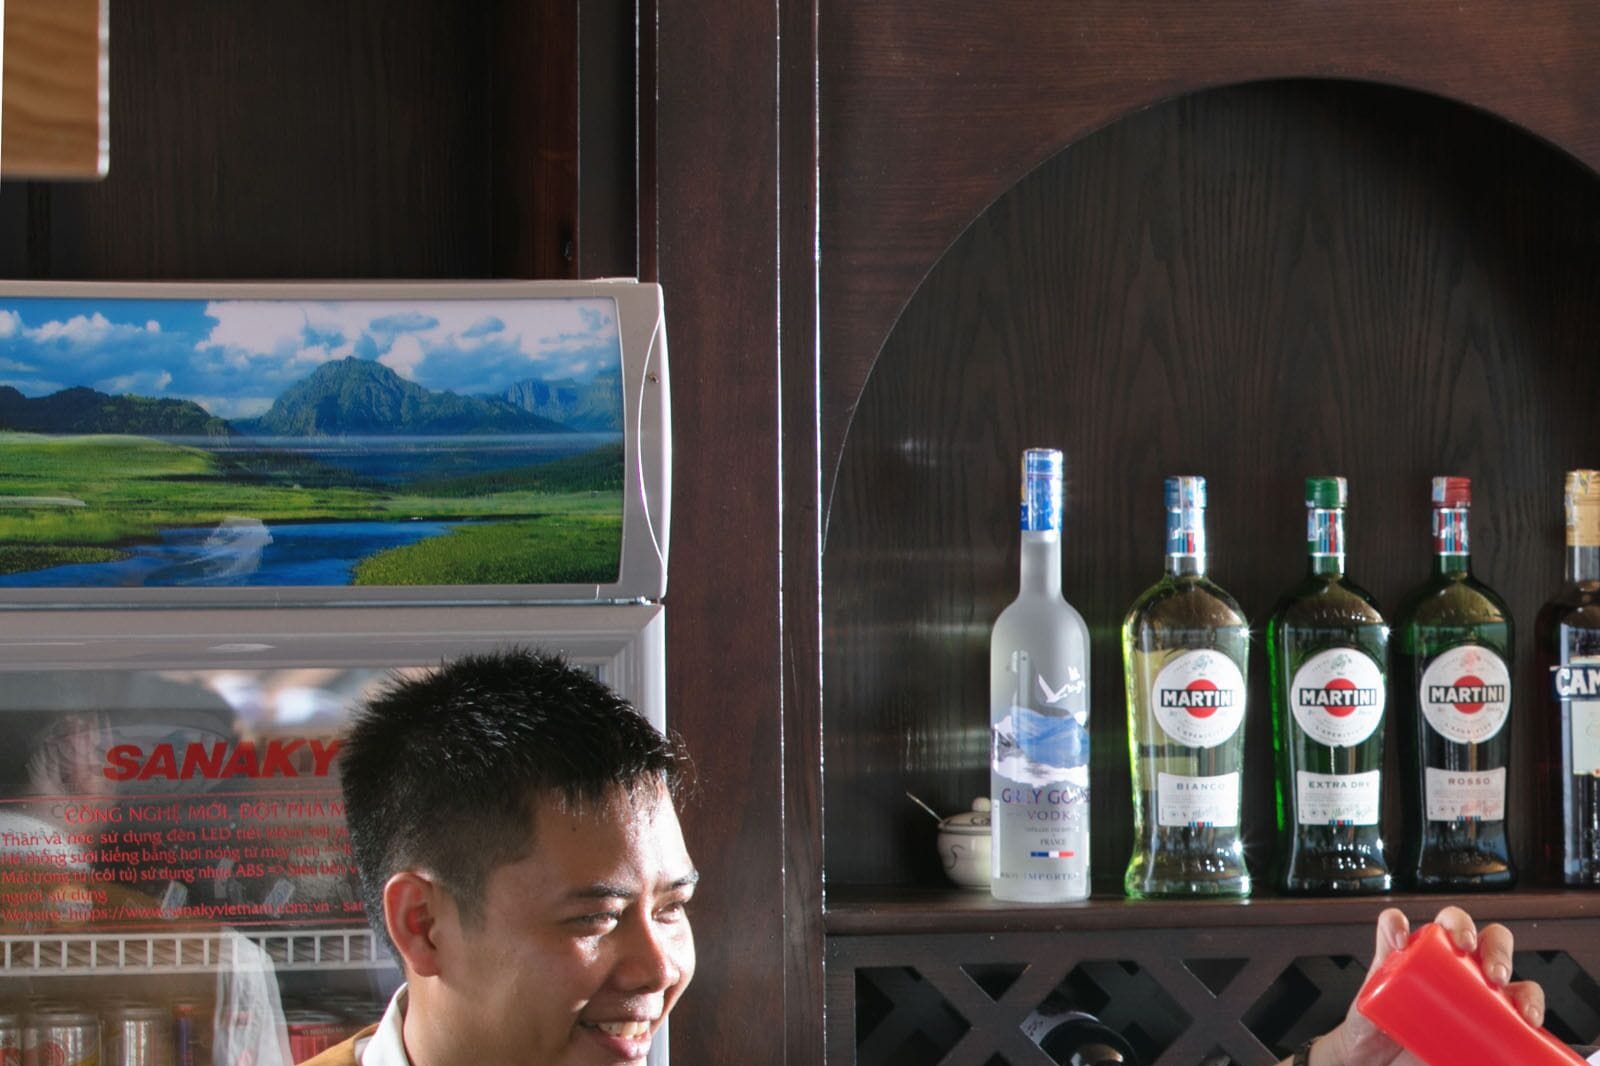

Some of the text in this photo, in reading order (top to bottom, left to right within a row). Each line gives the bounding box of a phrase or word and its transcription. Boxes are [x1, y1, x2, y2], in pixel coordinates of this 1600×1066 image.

[1302, 688, 1377, 706] MARTINI
[1431, 685, 1504, 704] MARTINI
[103, 738, 342, 782] SANAKY
[1176, 782, 1226, 792] BIANCO
[1308, 780, 1347, 790] EXTRA
[1448, 777, 1491, 786] ROSSO
[64, 804, 122, 825] CÔNG
[201, 826, 231, 841] LED
[236, 864, 265, 878] ABS
